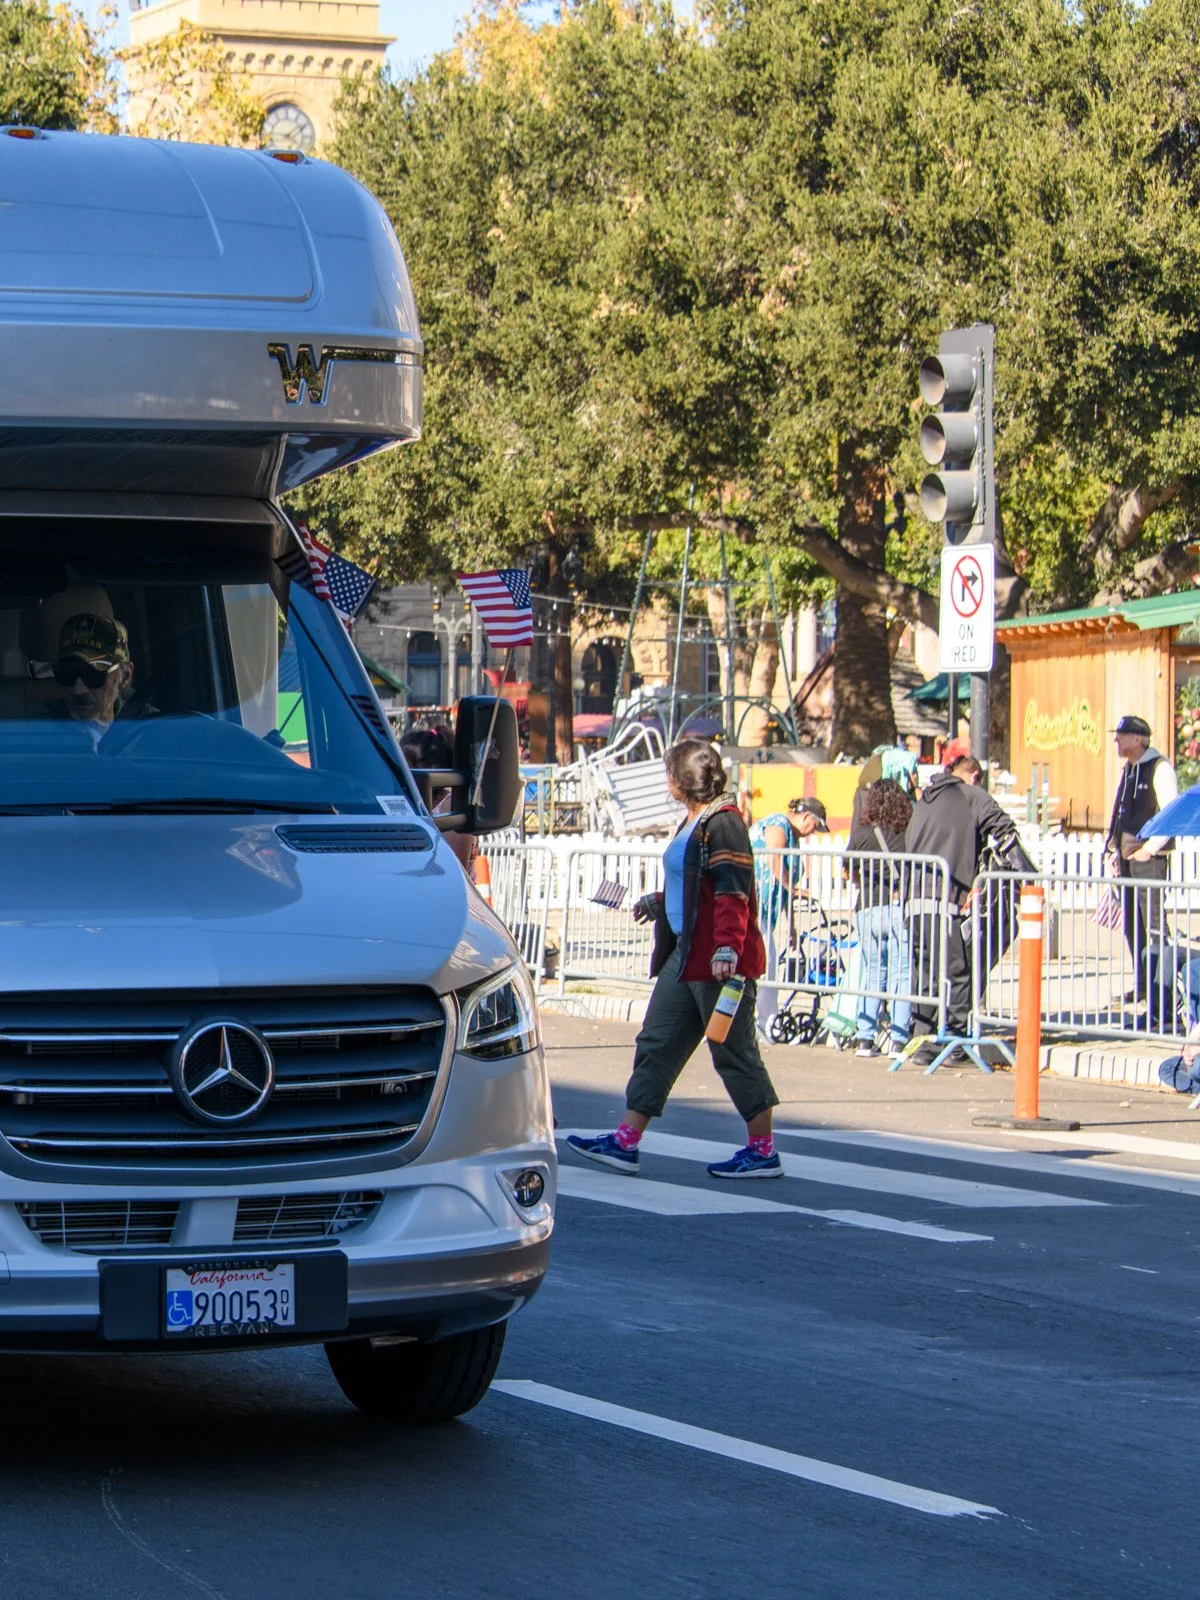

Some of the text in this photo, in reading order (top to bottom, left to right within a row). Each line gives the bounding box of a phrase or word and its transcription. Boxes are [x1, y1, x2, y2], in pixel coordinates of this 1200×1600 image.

[267, 342, 335, 406] W
[959, 624, 974, 640] ON
[953, 645, 977, 663] RED
[190, 1271, 273, 1288] California
[195, 1289, 278, 1324] 90053
